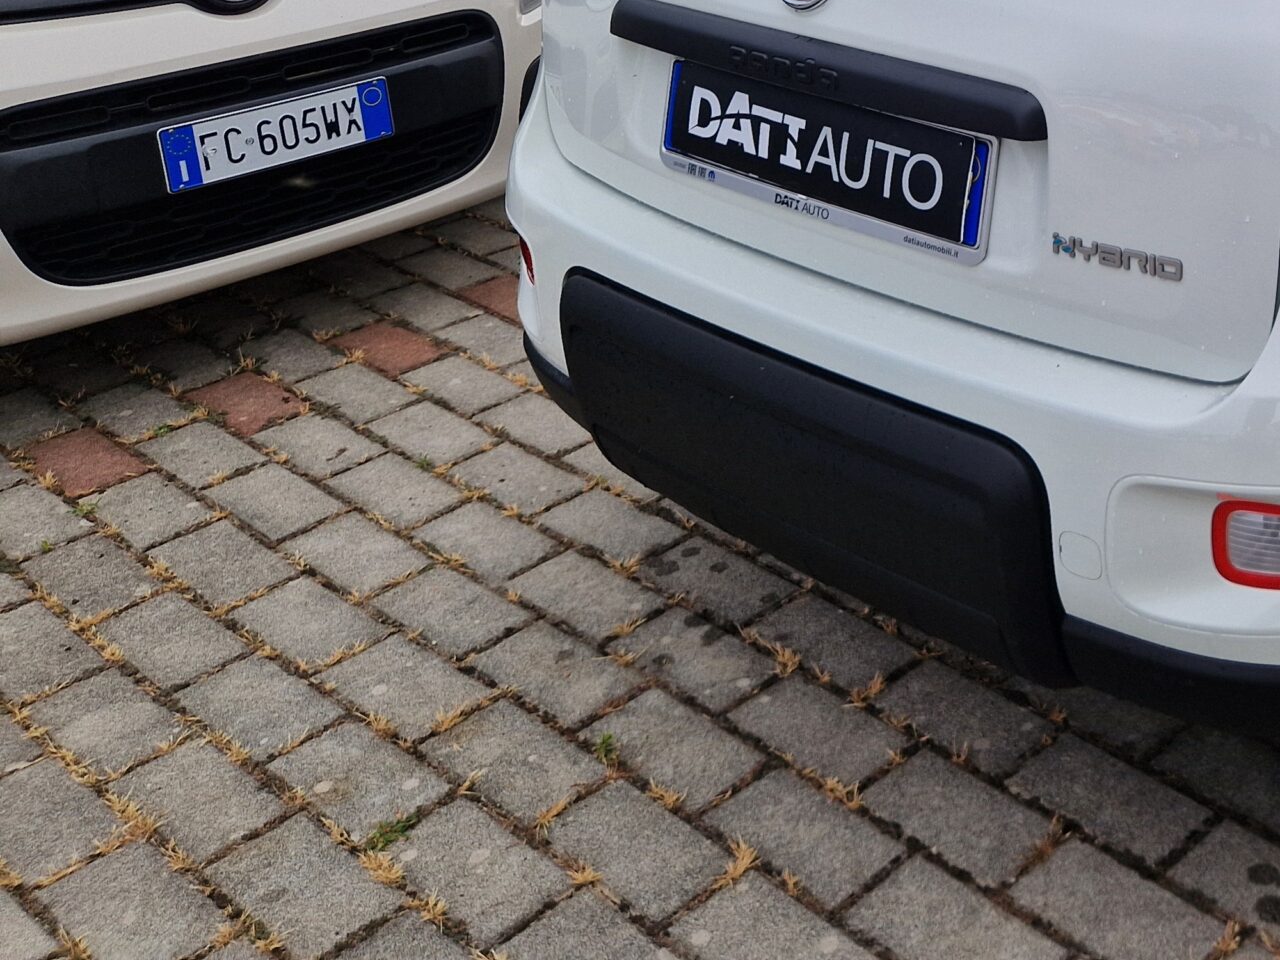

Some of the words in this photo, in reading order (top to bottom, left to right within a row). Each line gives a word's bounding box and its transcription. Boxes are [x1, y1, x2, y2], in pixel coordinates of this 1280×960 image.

[256, 96, 362, 156] 605WX
[802, 202, 830, 220] AUTO
[903, 235, 959, 258] datiautomobili.it
